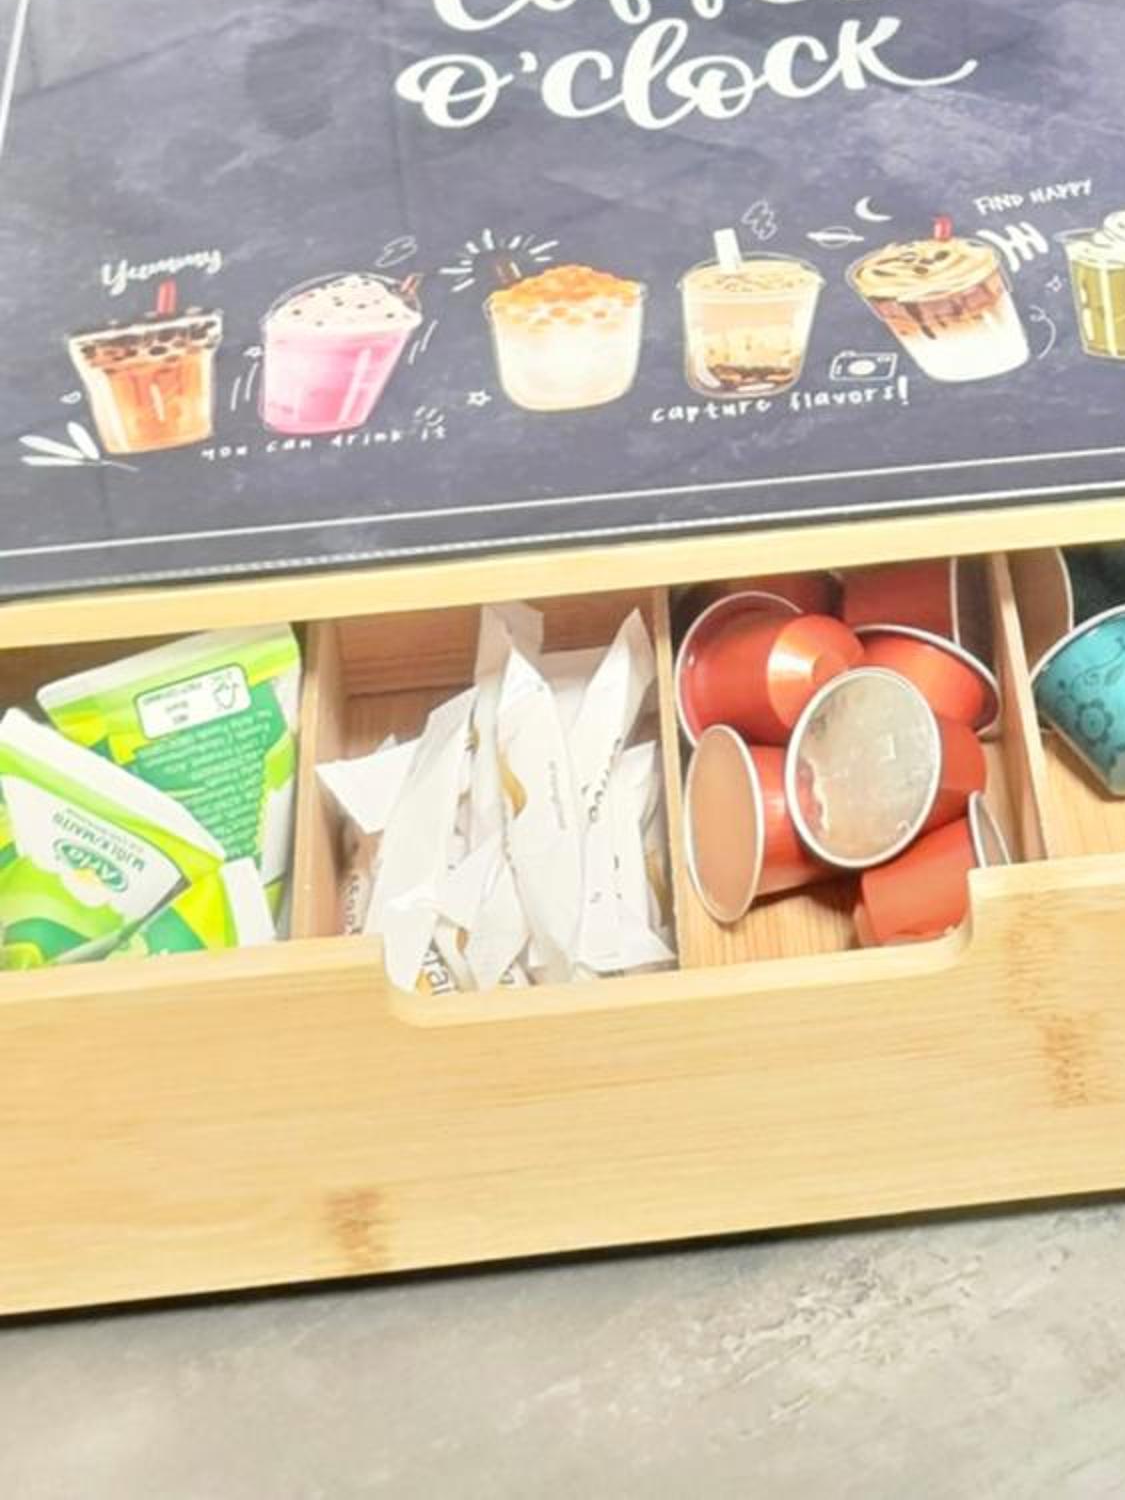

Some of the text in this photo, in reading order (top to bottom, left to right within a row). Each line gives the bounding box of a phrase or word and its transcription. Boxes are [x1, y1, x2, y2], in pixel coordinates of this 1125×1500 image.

[973, 177, 1092, 216] FIND HAPPY
[651, 399, 772, 424] capture
[265, 438, 313, 453] can
[330, 429, 402, 448] drink
[420, 425, 447, 442] it
